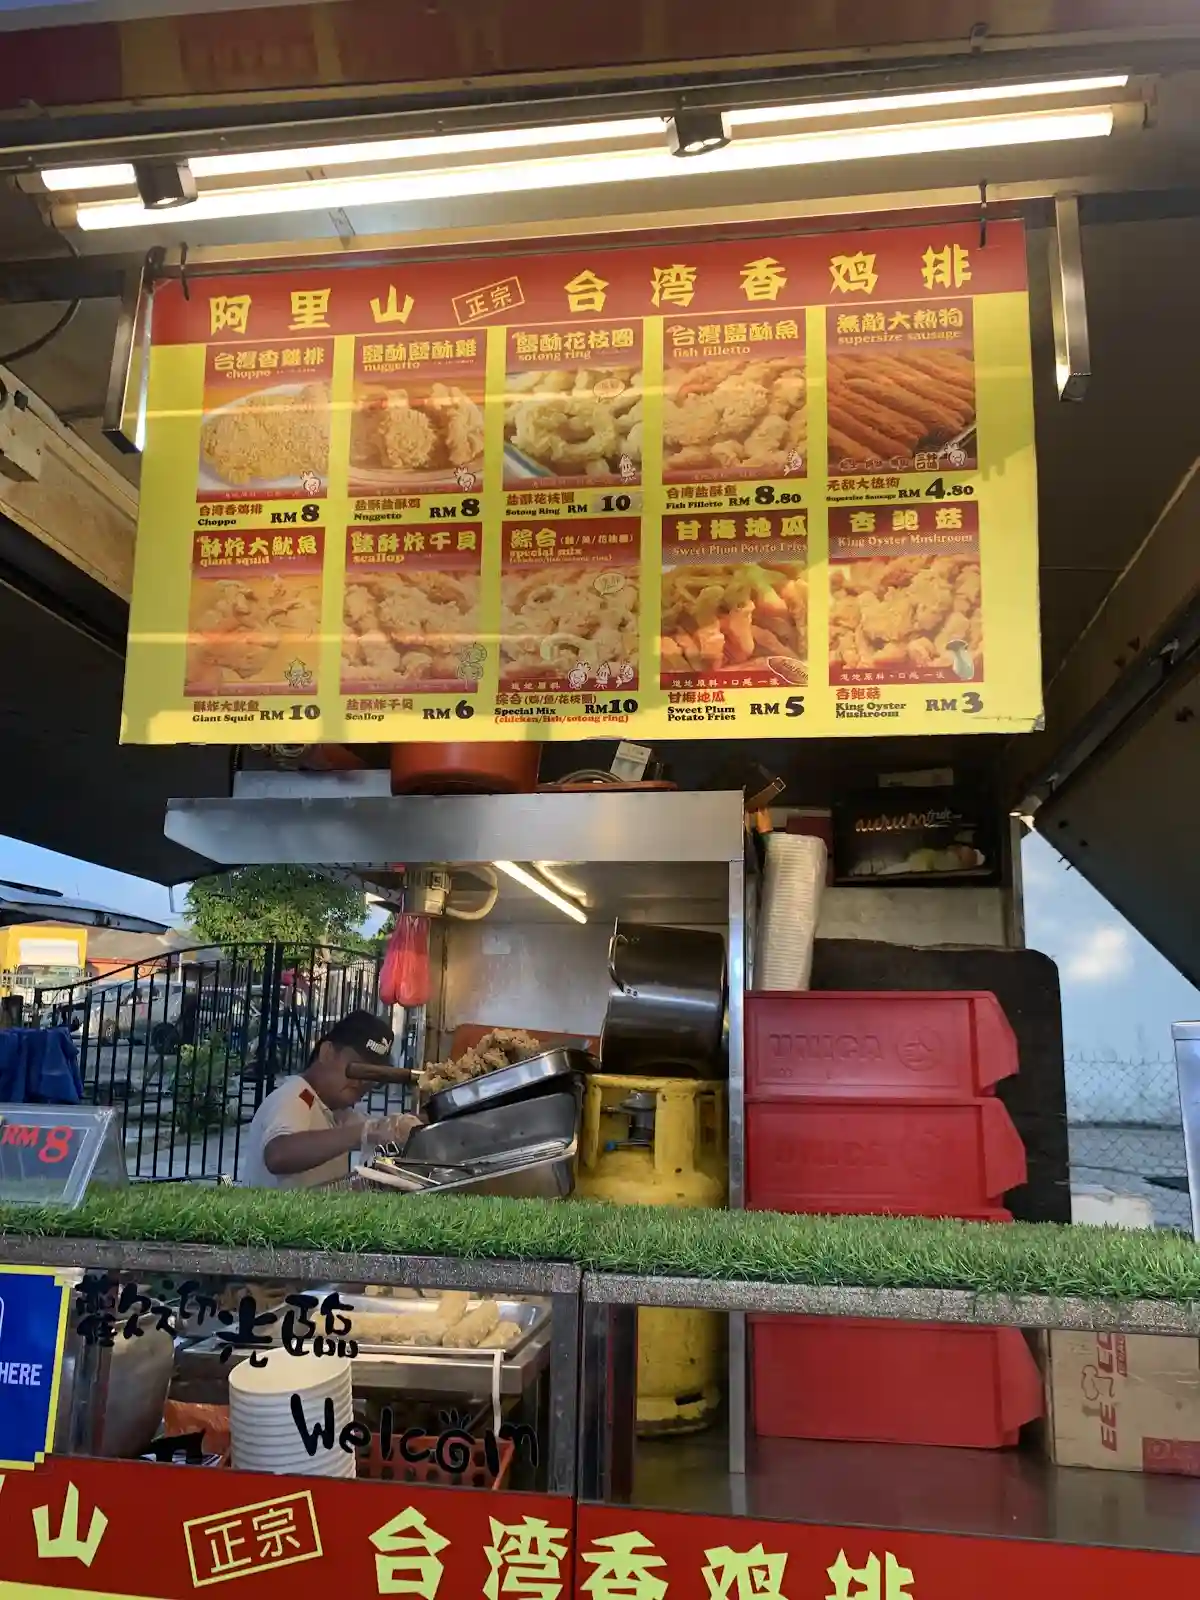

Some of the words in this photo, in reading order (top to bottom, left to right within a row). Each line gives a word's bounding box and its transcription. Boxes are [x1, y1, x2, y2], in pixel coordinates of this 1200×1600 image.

[209, 284, 415, 336] 阿里山
[465, 285, 513, 318] 正宗
[564, 243, 972, 314] 台湾香鸡排
[565, 349, 591, 360] ring
[728, 497, 751, 506] RM
[755, 486, 801, 505] 8.80
[898, 489, 920, 498] RM
[925, 478, 974, 499] 4.80
[430, 506, 457, 518] RM
[461, 498, 480, 516] 8
[567, 504, 588, 513] RM
[601, 494, 631, 511] 10
[270, 512, 297, 523] RM
[301, 504, 320, 522] 8
[838, 536, 864, 547] King
[867, 535, 904, 546] Oyster
[910, 533, 972, 544] Mushroom
[353, 553, 405, 564] scallop
[423, 708, 450, 719] RM
[455, 700, 474, 719] 6
[585, 704, 608, 714] RM
[608, 699, 638, 714] 10
[668, 706, 703, 714] Sweet
[750, 703, 780, 714] RM
[785, 696, 805, 717] 5
[836, 703, 864, 711] King
[867, 702, 907, 711] Oyster
[926, 699, 957, 711] RM
[962, 692, 983, 713] 3
[224, 714, 254, 723] Squid
[260, 710, 284, 720] RM
[289, 705, 320, 720] 10
[345, 713, 384, 721] Scallop
[494, 707, 533, 716] Special
[536, 707, 556, 715] Mix
[668, 713, 704, 721] Potato
[707, 713, 736, 721] Fries
[836, 710, 899, 718] Mushroom
[2, 1125, 39, 1147] RM
[38, 1125, 73, 1163] 8
[0, 1362, 43, 1386] HERE
[205, 1508, 302, 1574] 正宗
